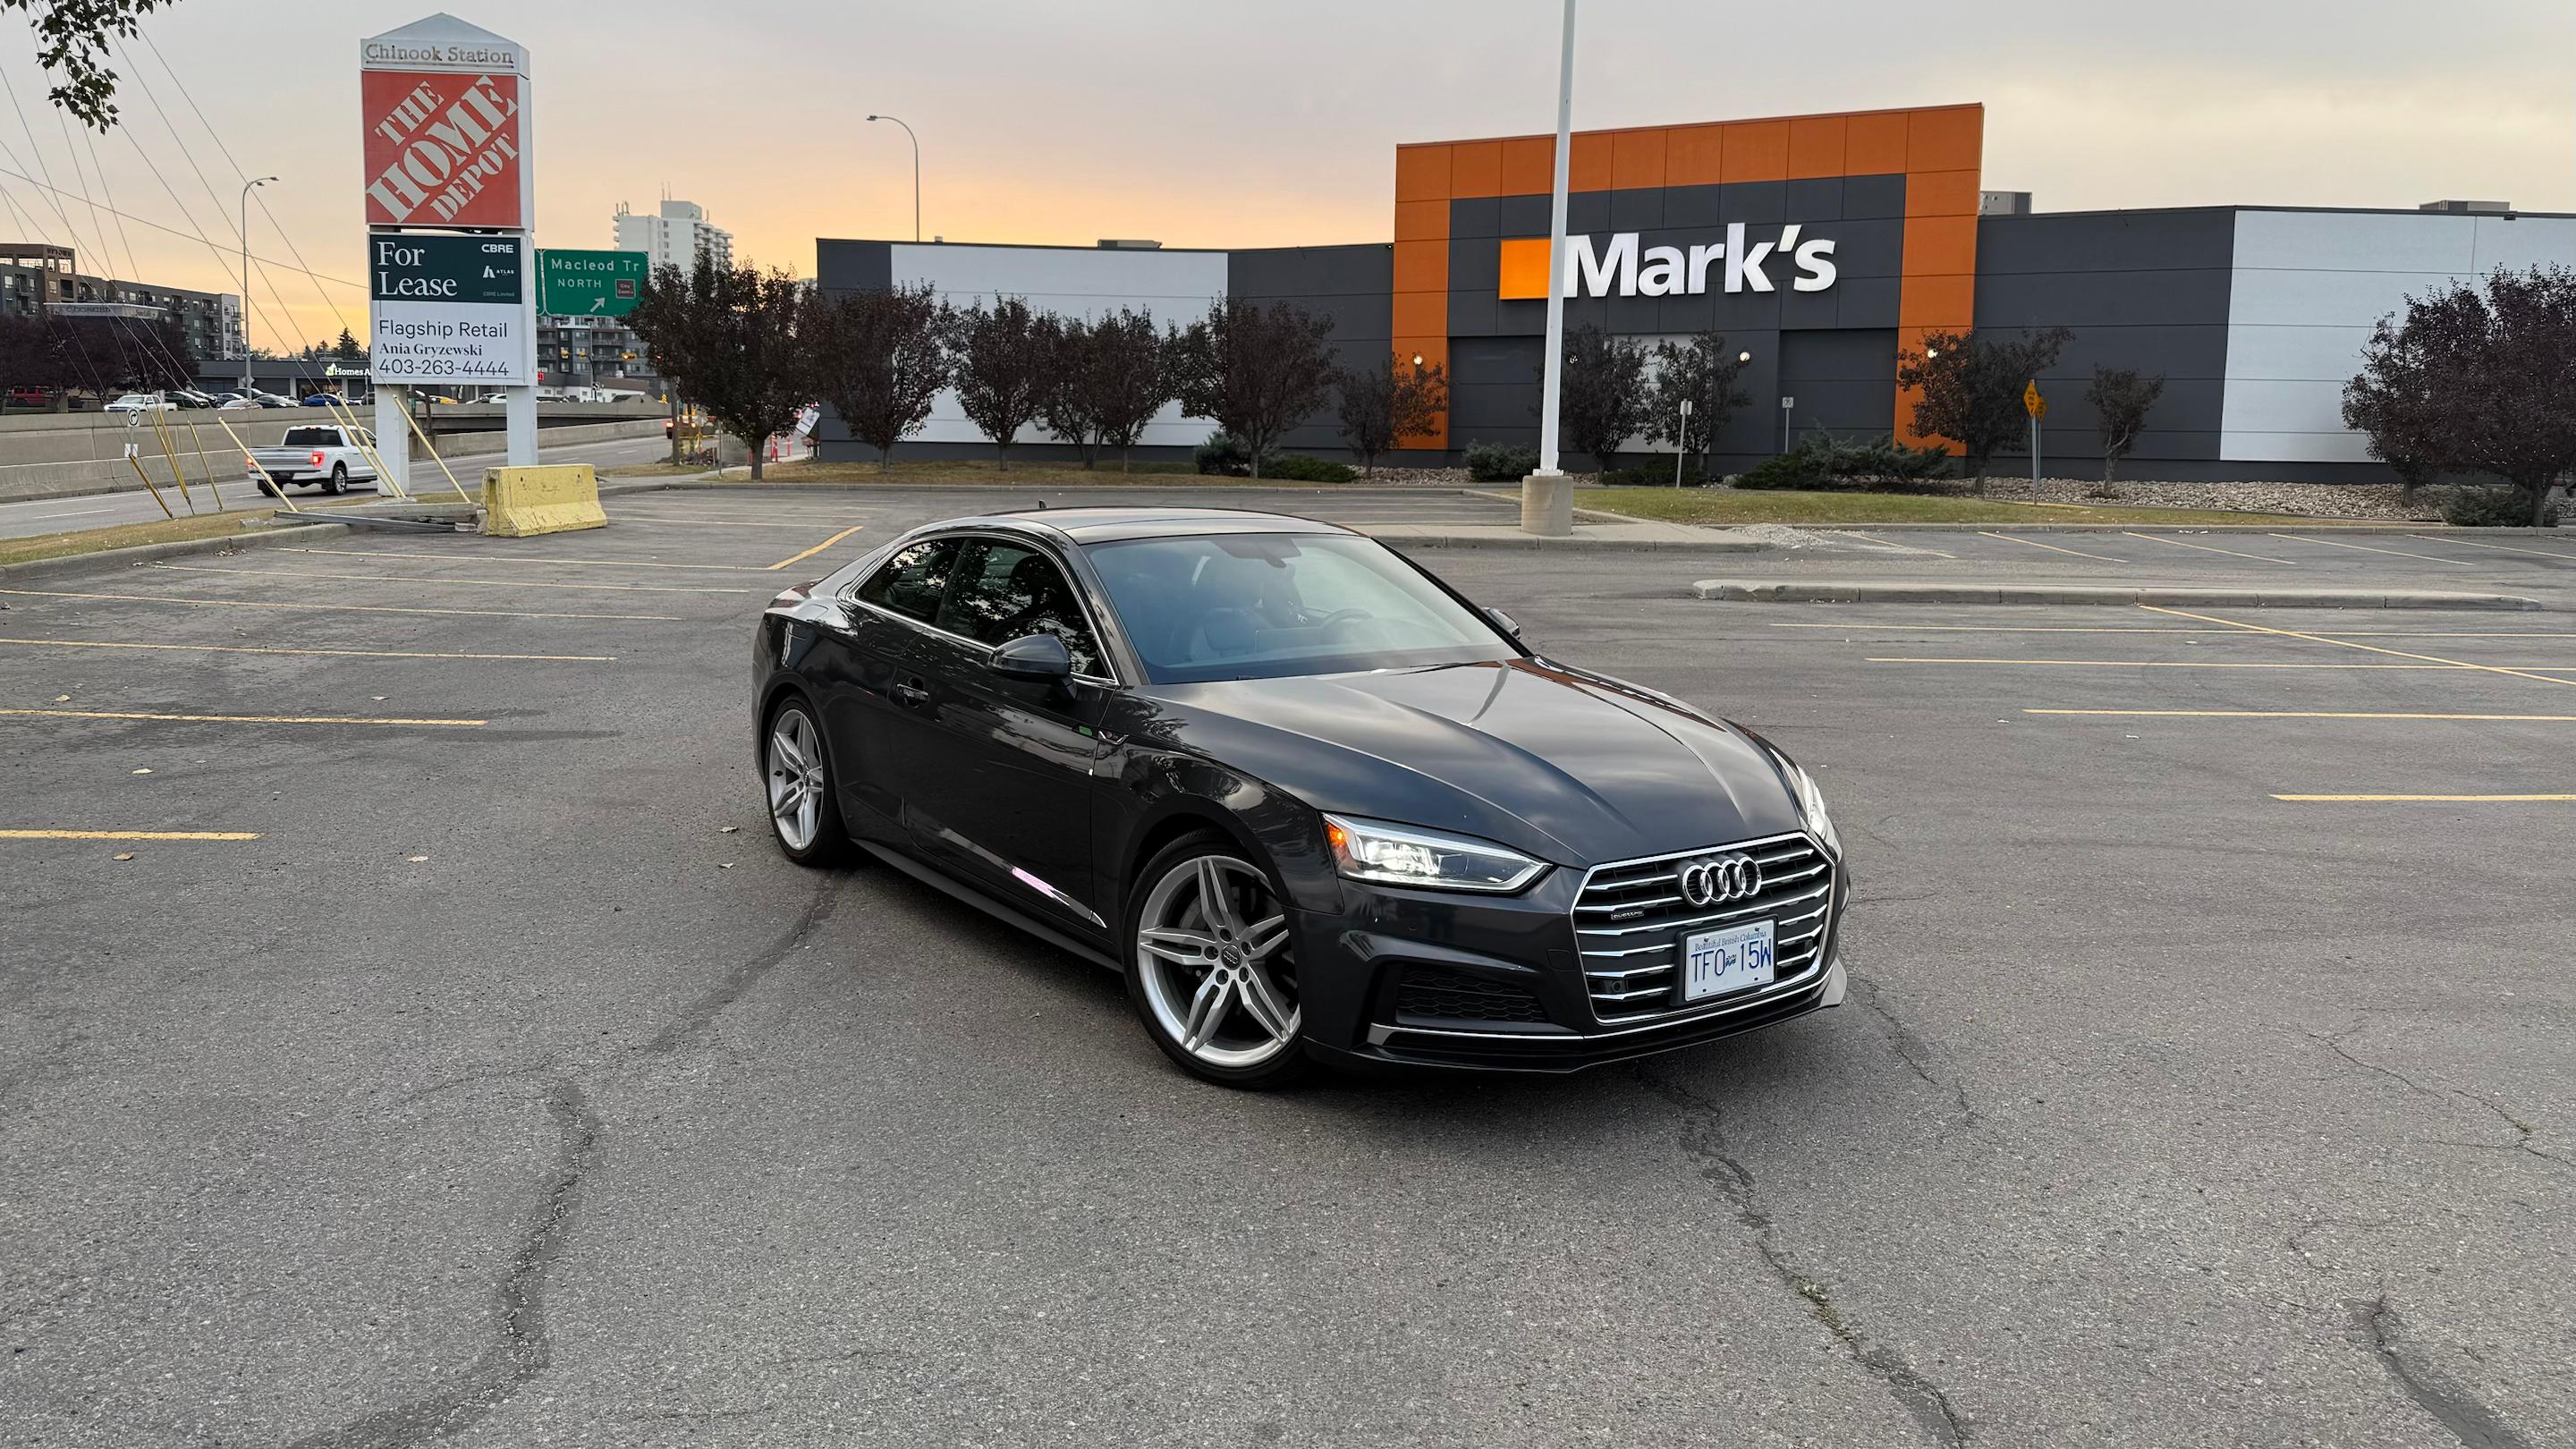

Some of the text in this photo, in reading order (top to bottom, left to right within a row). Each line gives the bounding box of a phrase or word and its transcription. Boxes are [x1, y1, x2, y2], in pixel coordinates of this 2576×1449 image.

[365, 44, 513, 64] Chinook Station
[374, 80, 445, 146] THE
[366, 74, 518, 223] HOME
[429, 131, 518, 223] DEPOT
[377, 242, 425, 267] For
[481, 243, 514, 253] CBRE
[551, 258, 640, 272] Macleod Tr
[1563, 222, 1837, 298] Mark's
[378, 271, 458, 297] Lease
[557, 278, 602, 288] NORTH
[379, 319, 507, 339] Flagship Retail
[379, 343, 482, 358] Ania Gryzewski
[335, 368, 363, 376] Homes
[379, 359, 509, 376] 403-263-4444
[1722, 936, 1740, 945] British
[1740, 930, 1767, 941] Columbia
[1741, 938, 1772, 972] 15W
